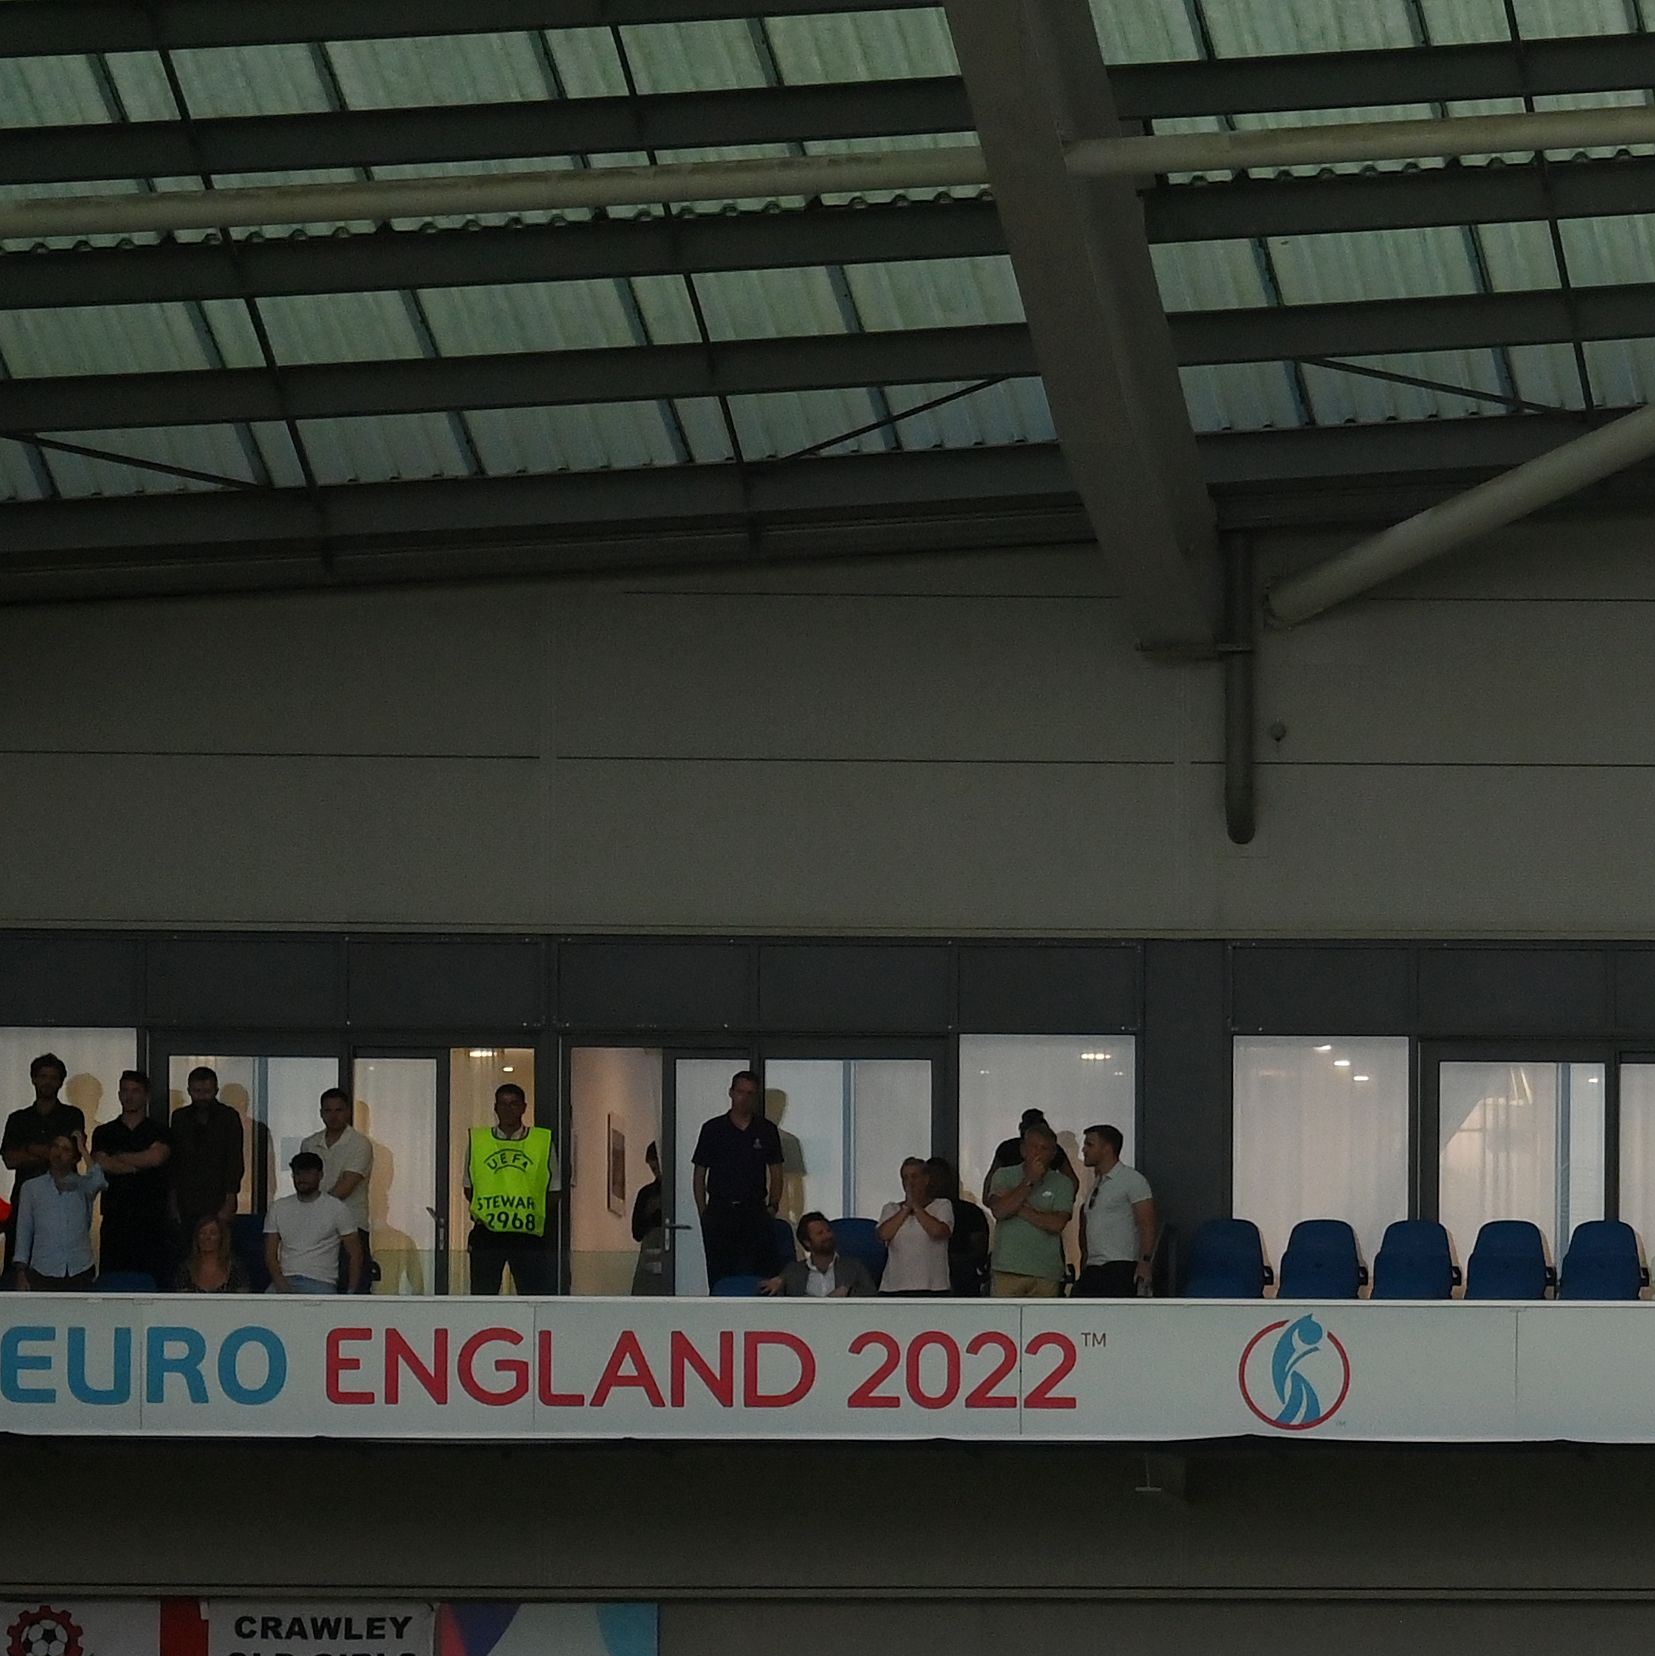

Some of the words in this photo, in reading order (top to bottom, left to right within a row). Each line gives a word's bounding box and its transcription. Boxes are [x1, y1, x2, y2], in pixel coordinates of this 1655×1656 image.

[477, 1195, 535, 1211] STEWAR
[1, 1326, 287, 1405] EURO
[326, 1328, 817, 1408] ENGLAND
[848, 1330, 1078, 1409] 2022
[233, 1615, 413, 1641] CRAWLEY
